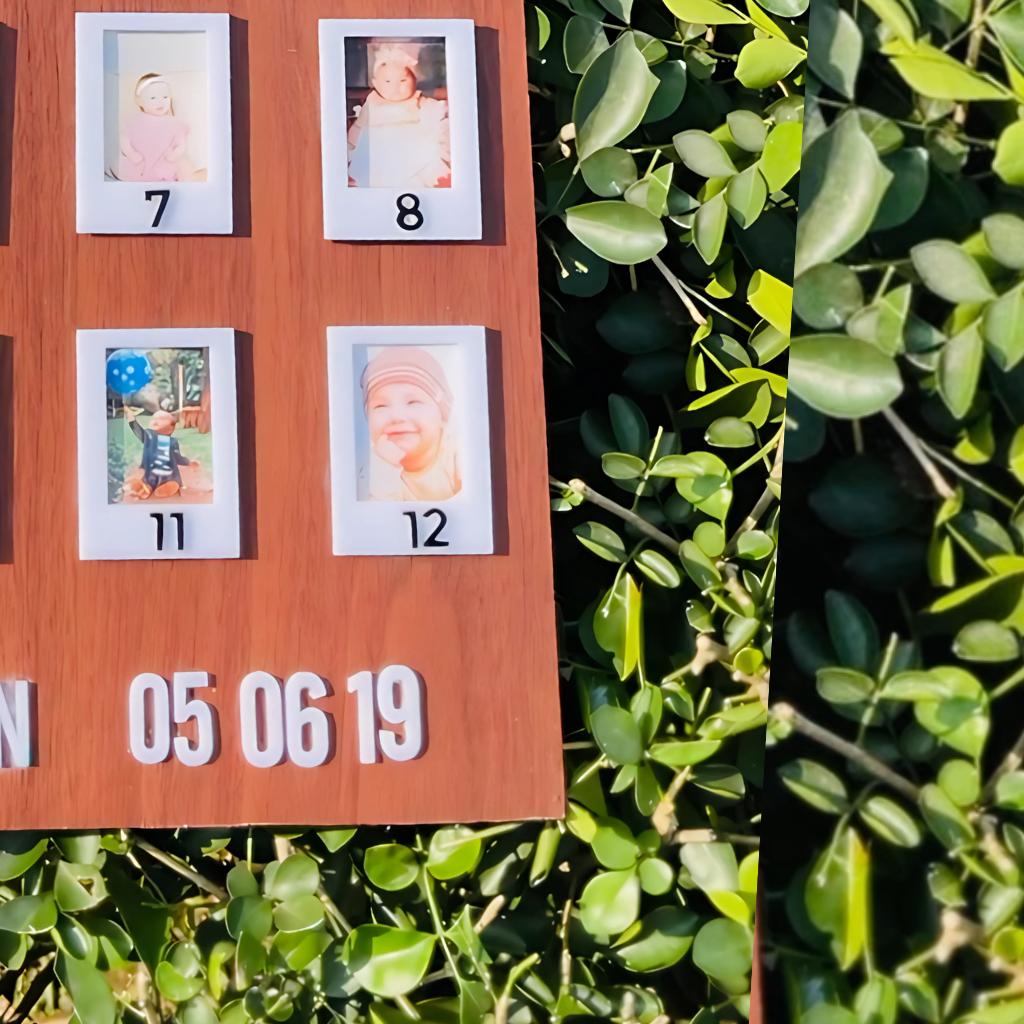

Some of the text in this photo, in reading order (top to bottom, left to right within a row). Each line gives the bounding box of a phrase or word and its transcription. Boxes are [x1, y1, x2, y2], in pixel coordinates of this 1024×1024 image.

[144, 189, 171, 227] 7
[396, 193, 424, 231] 8
[149, 512, 184, 551] 11
[402, 508, 449, 548] 12
[128, 671, 214, 767] 05
[239, 670, 331, 768] 06
[347, 664, 426, 764] 19
